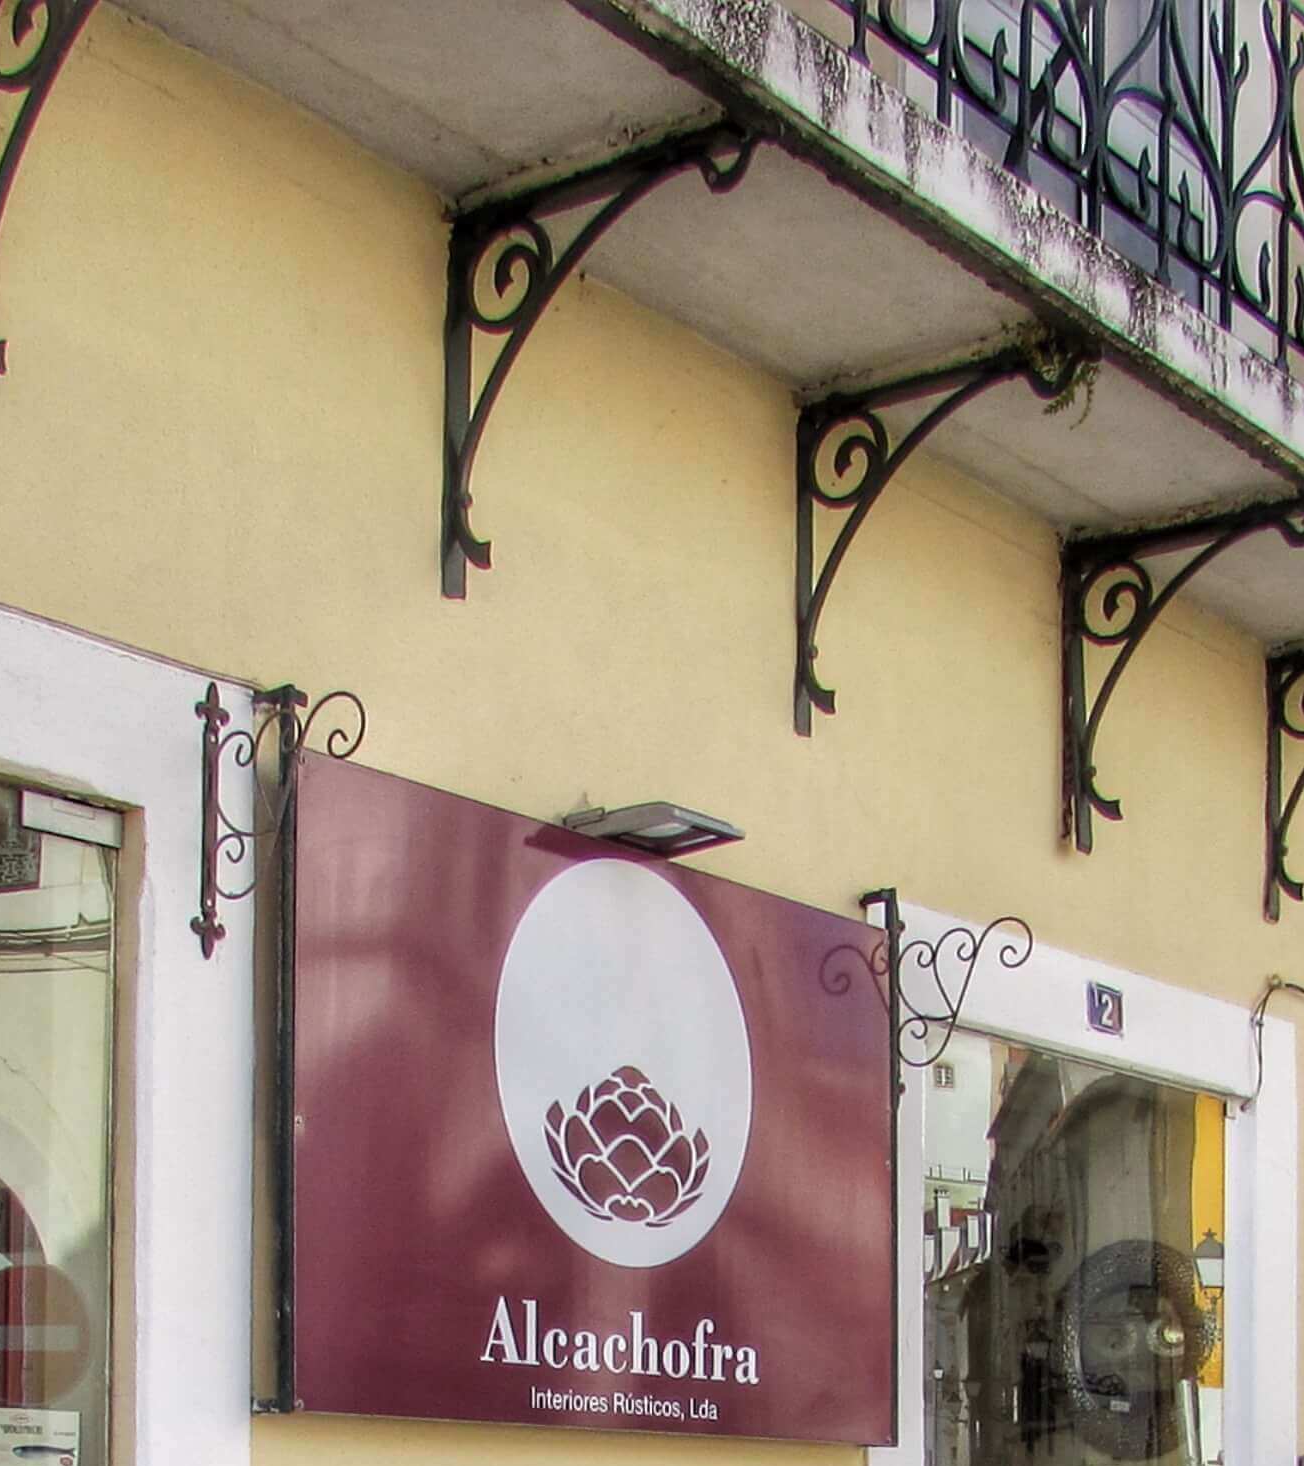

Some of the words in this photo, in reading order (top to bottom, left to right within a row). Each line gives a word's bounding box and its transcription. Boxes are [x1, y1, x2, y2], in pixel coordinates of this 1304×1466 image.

[1101, 993, 1113, 1027] 2
[480, 1295, 760, 1385] Alcachofra
[531, 1386, 608, 1413] Interiores
[613, 1392, 685, 1422] Rústicos,
[690, 1398, 718, 1420] Lda
